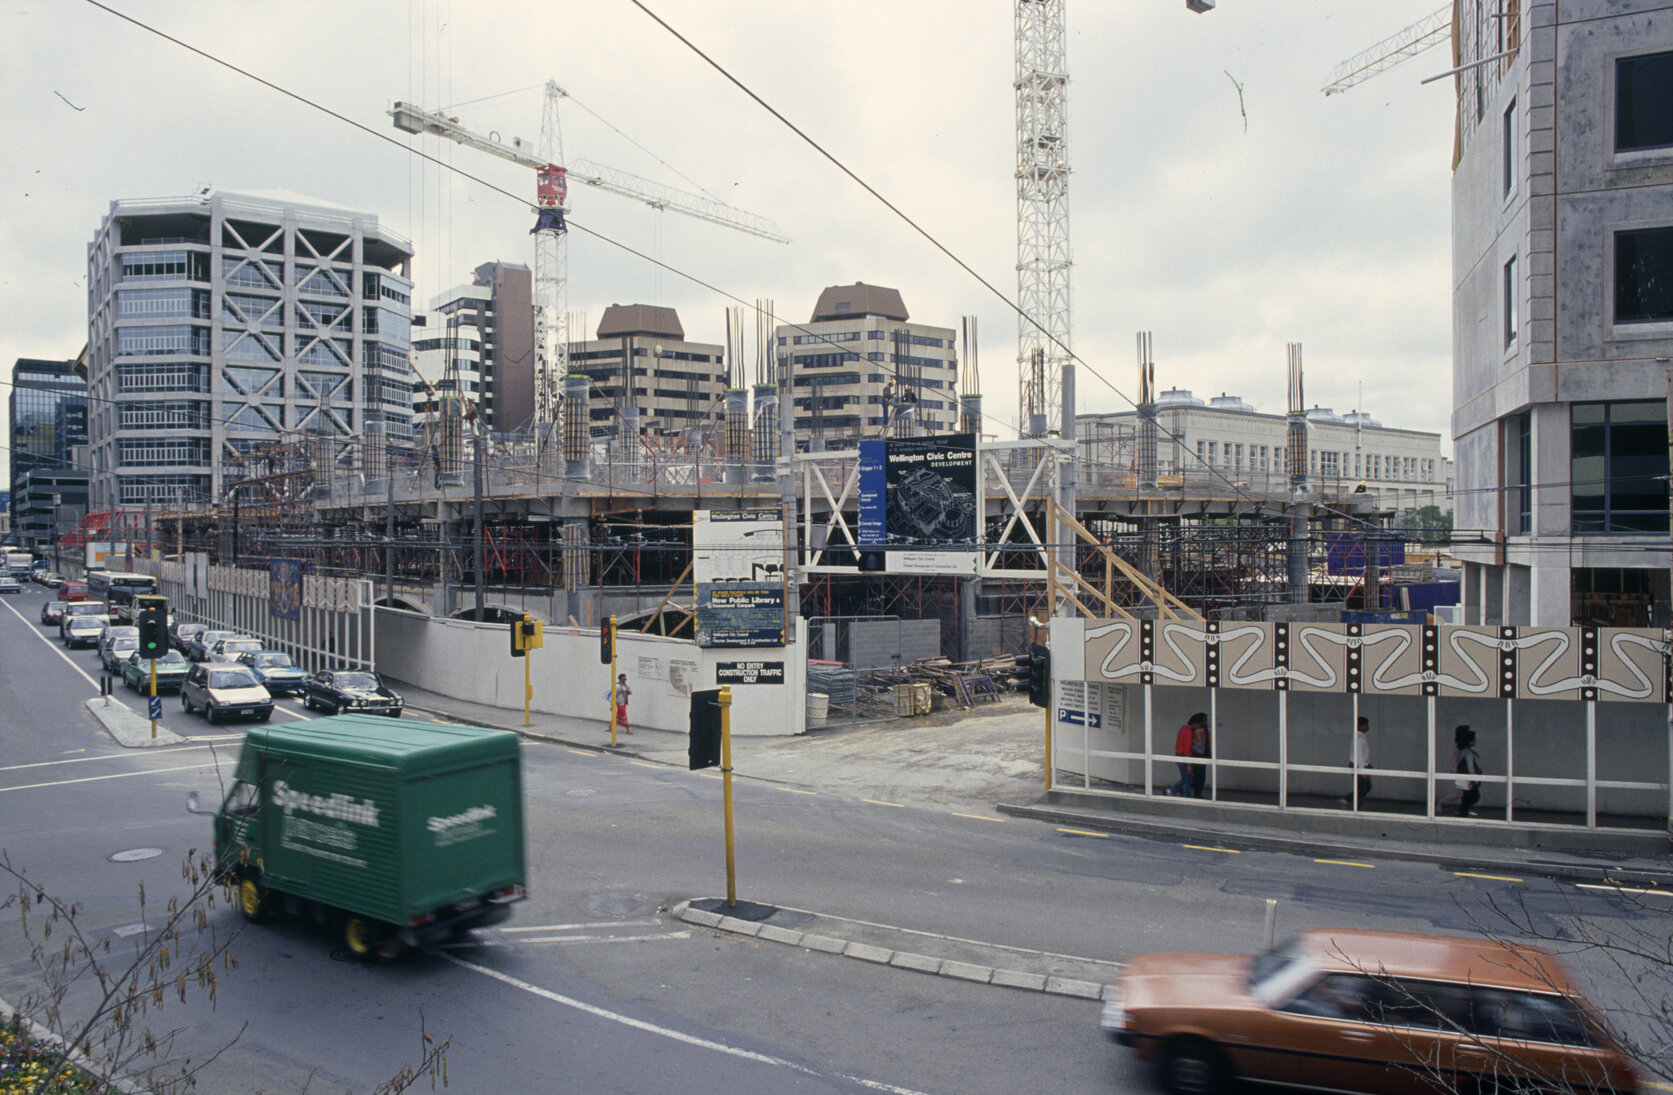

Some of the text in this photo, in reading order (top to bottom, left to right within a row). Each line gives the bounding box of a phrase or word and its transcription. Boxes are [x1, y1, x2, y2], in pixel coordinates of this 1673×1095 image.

[889, 454, 924, 463] Wellington
[947, 451, 972, 460] Centre
[1059, 710, 1066, 720] P
